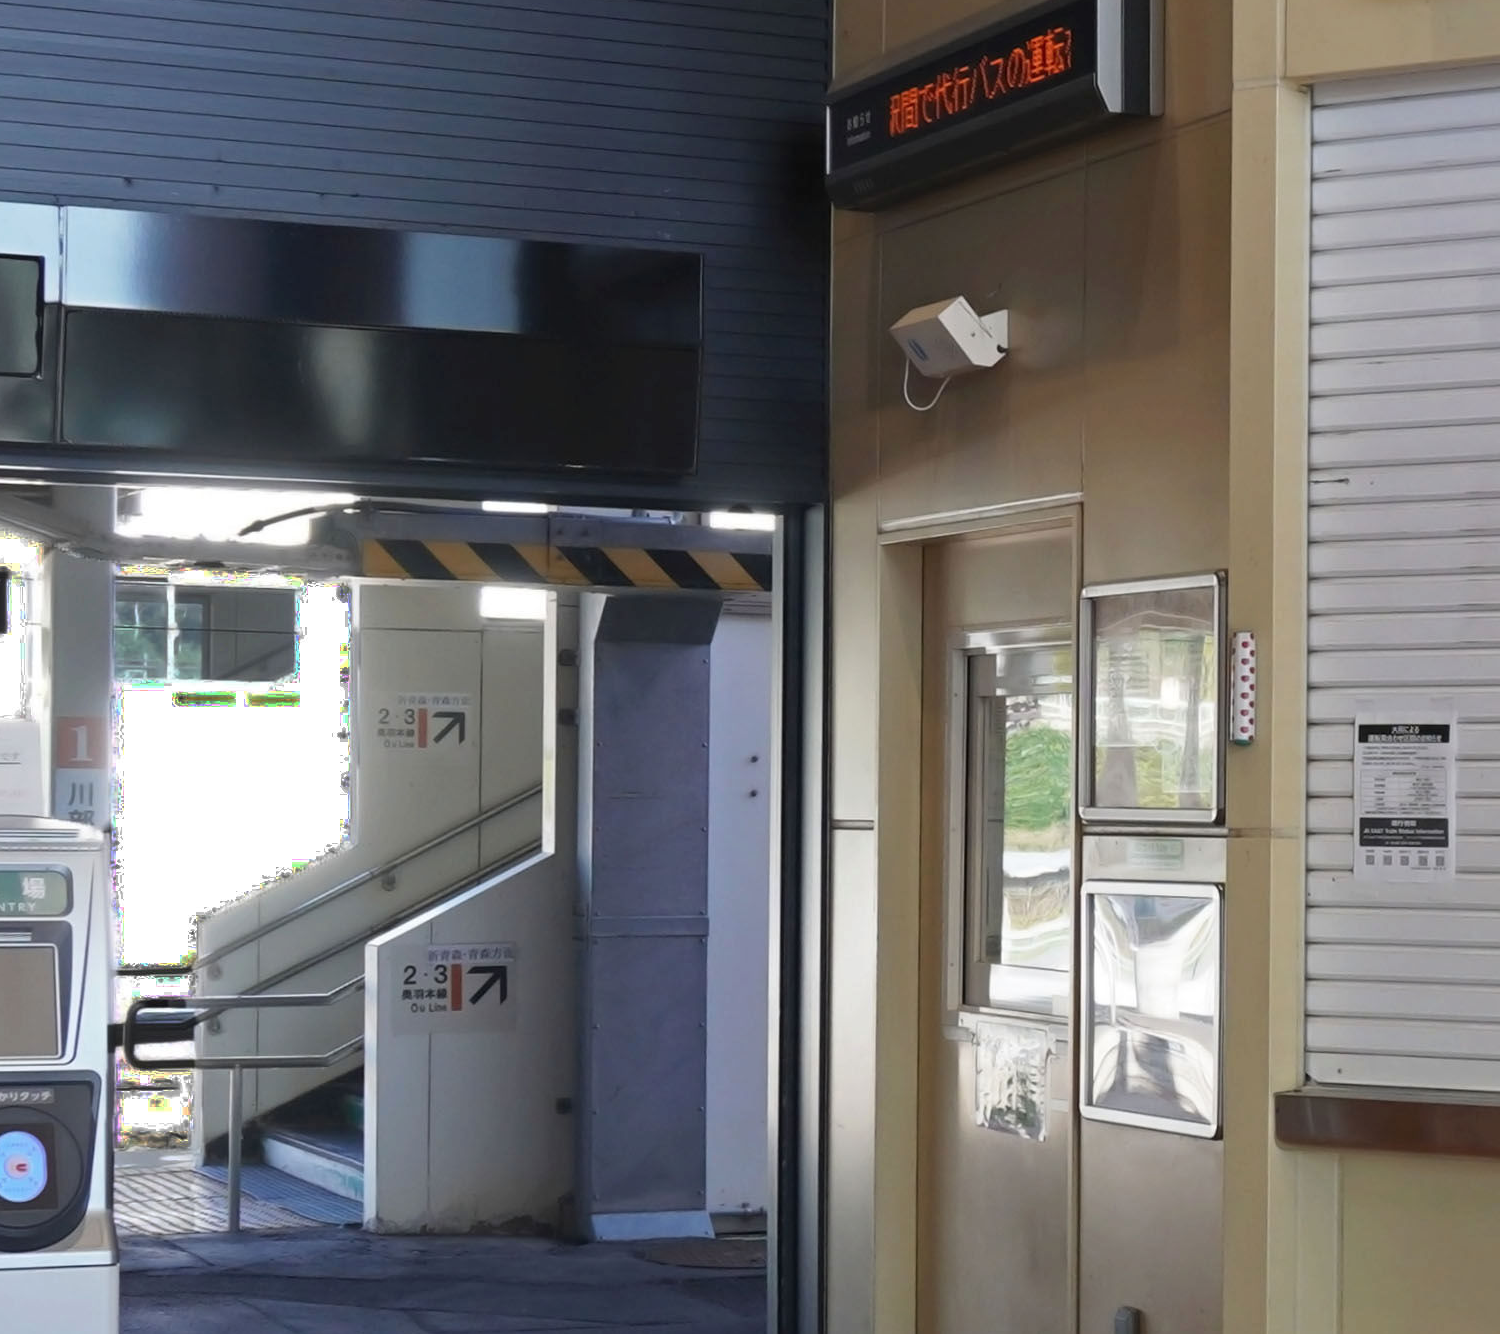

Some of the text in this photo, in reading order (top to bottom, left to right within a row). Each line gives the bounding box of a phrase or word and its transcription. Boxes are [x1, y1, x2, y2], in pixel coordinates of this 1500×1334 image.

[378, 708, 416, 725] 2・3
[69, 725, 93, 761] 1
[403, 965, 448, 985] 2・3
[402, 989, 447, 1000] 奥羽本線
[411, 1003, 425, 1013] Ou
